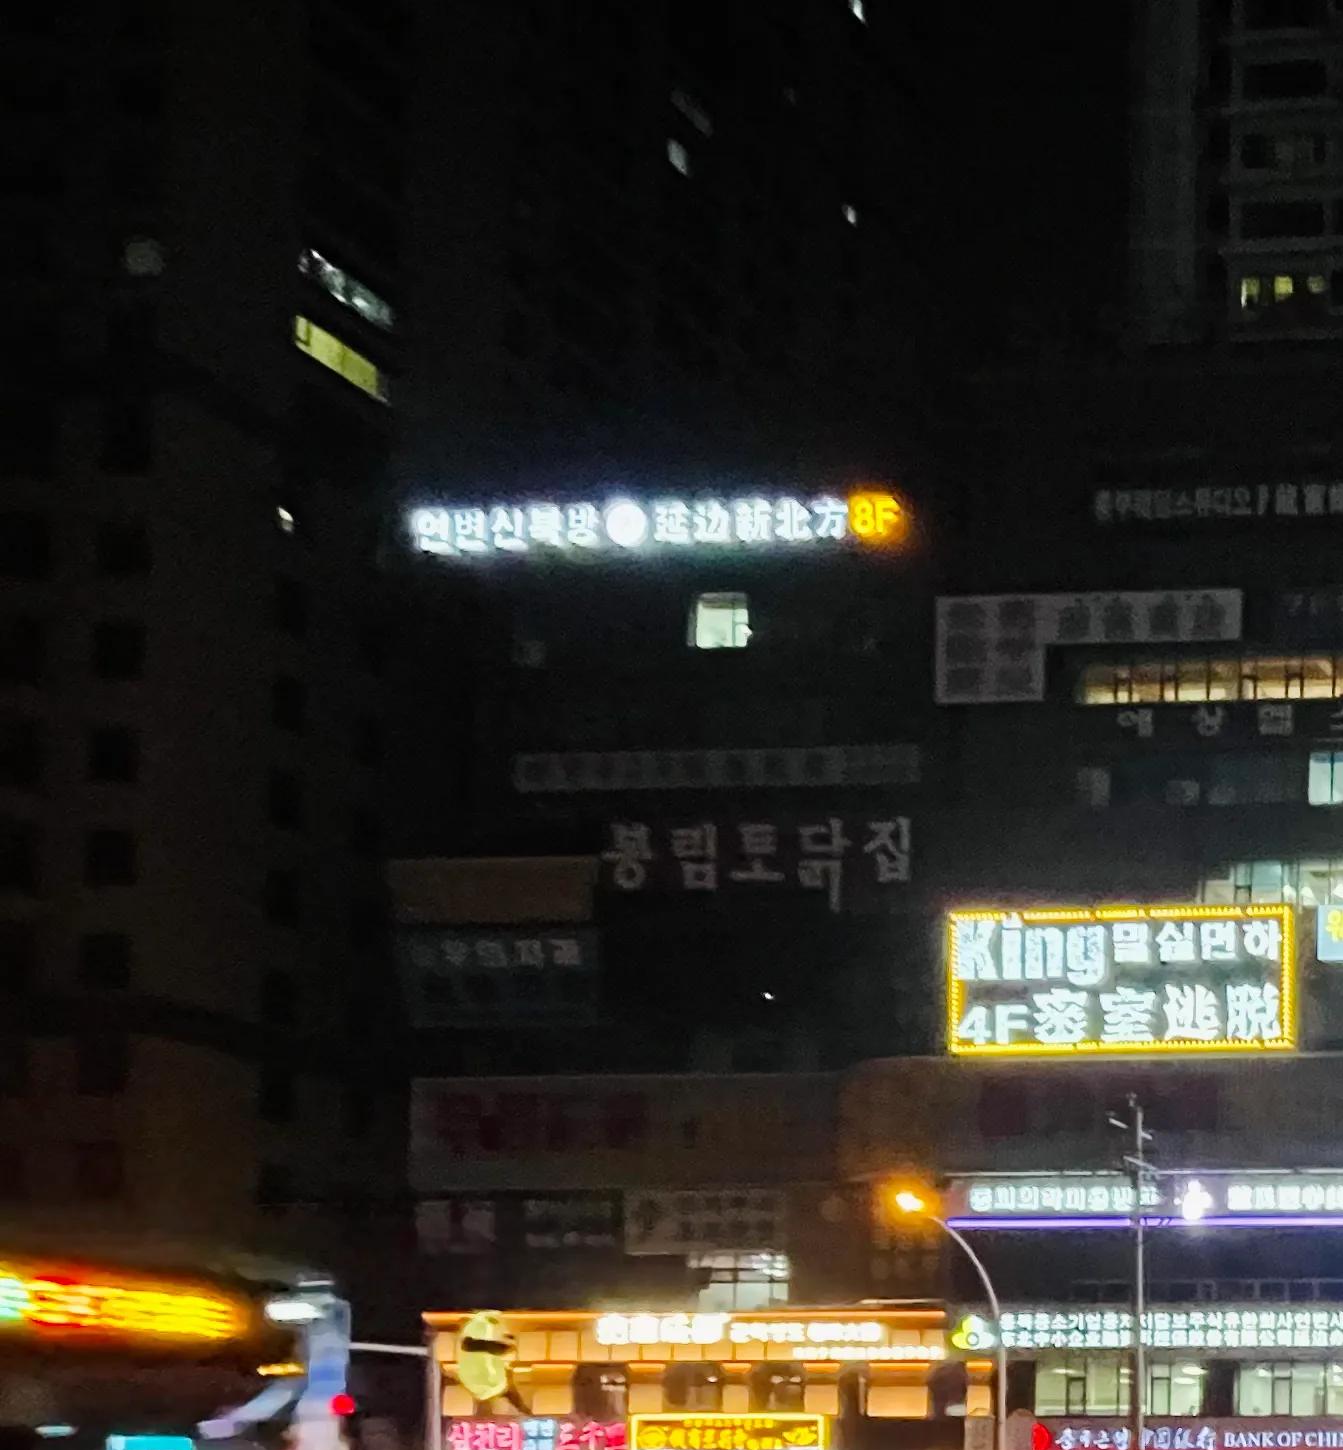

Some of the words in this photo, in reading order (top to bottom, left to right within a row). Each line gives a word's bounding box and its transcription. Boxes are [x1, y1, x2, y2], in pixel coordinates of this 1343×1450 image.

[412, 501, 600, 553] 연변신북방
[652, 497, 847, 544] 延边新北方
[849, 491, 900, 536] 8F
[957, 912, 1106, 986] King
[959, 1004, 1031, 1045] 4F
[1032, 982, 1282, 1043] 密室逃脱
[1224, 1431, 1275, 1448] BANK
[1276, 1431, 1303, 1448] OF
